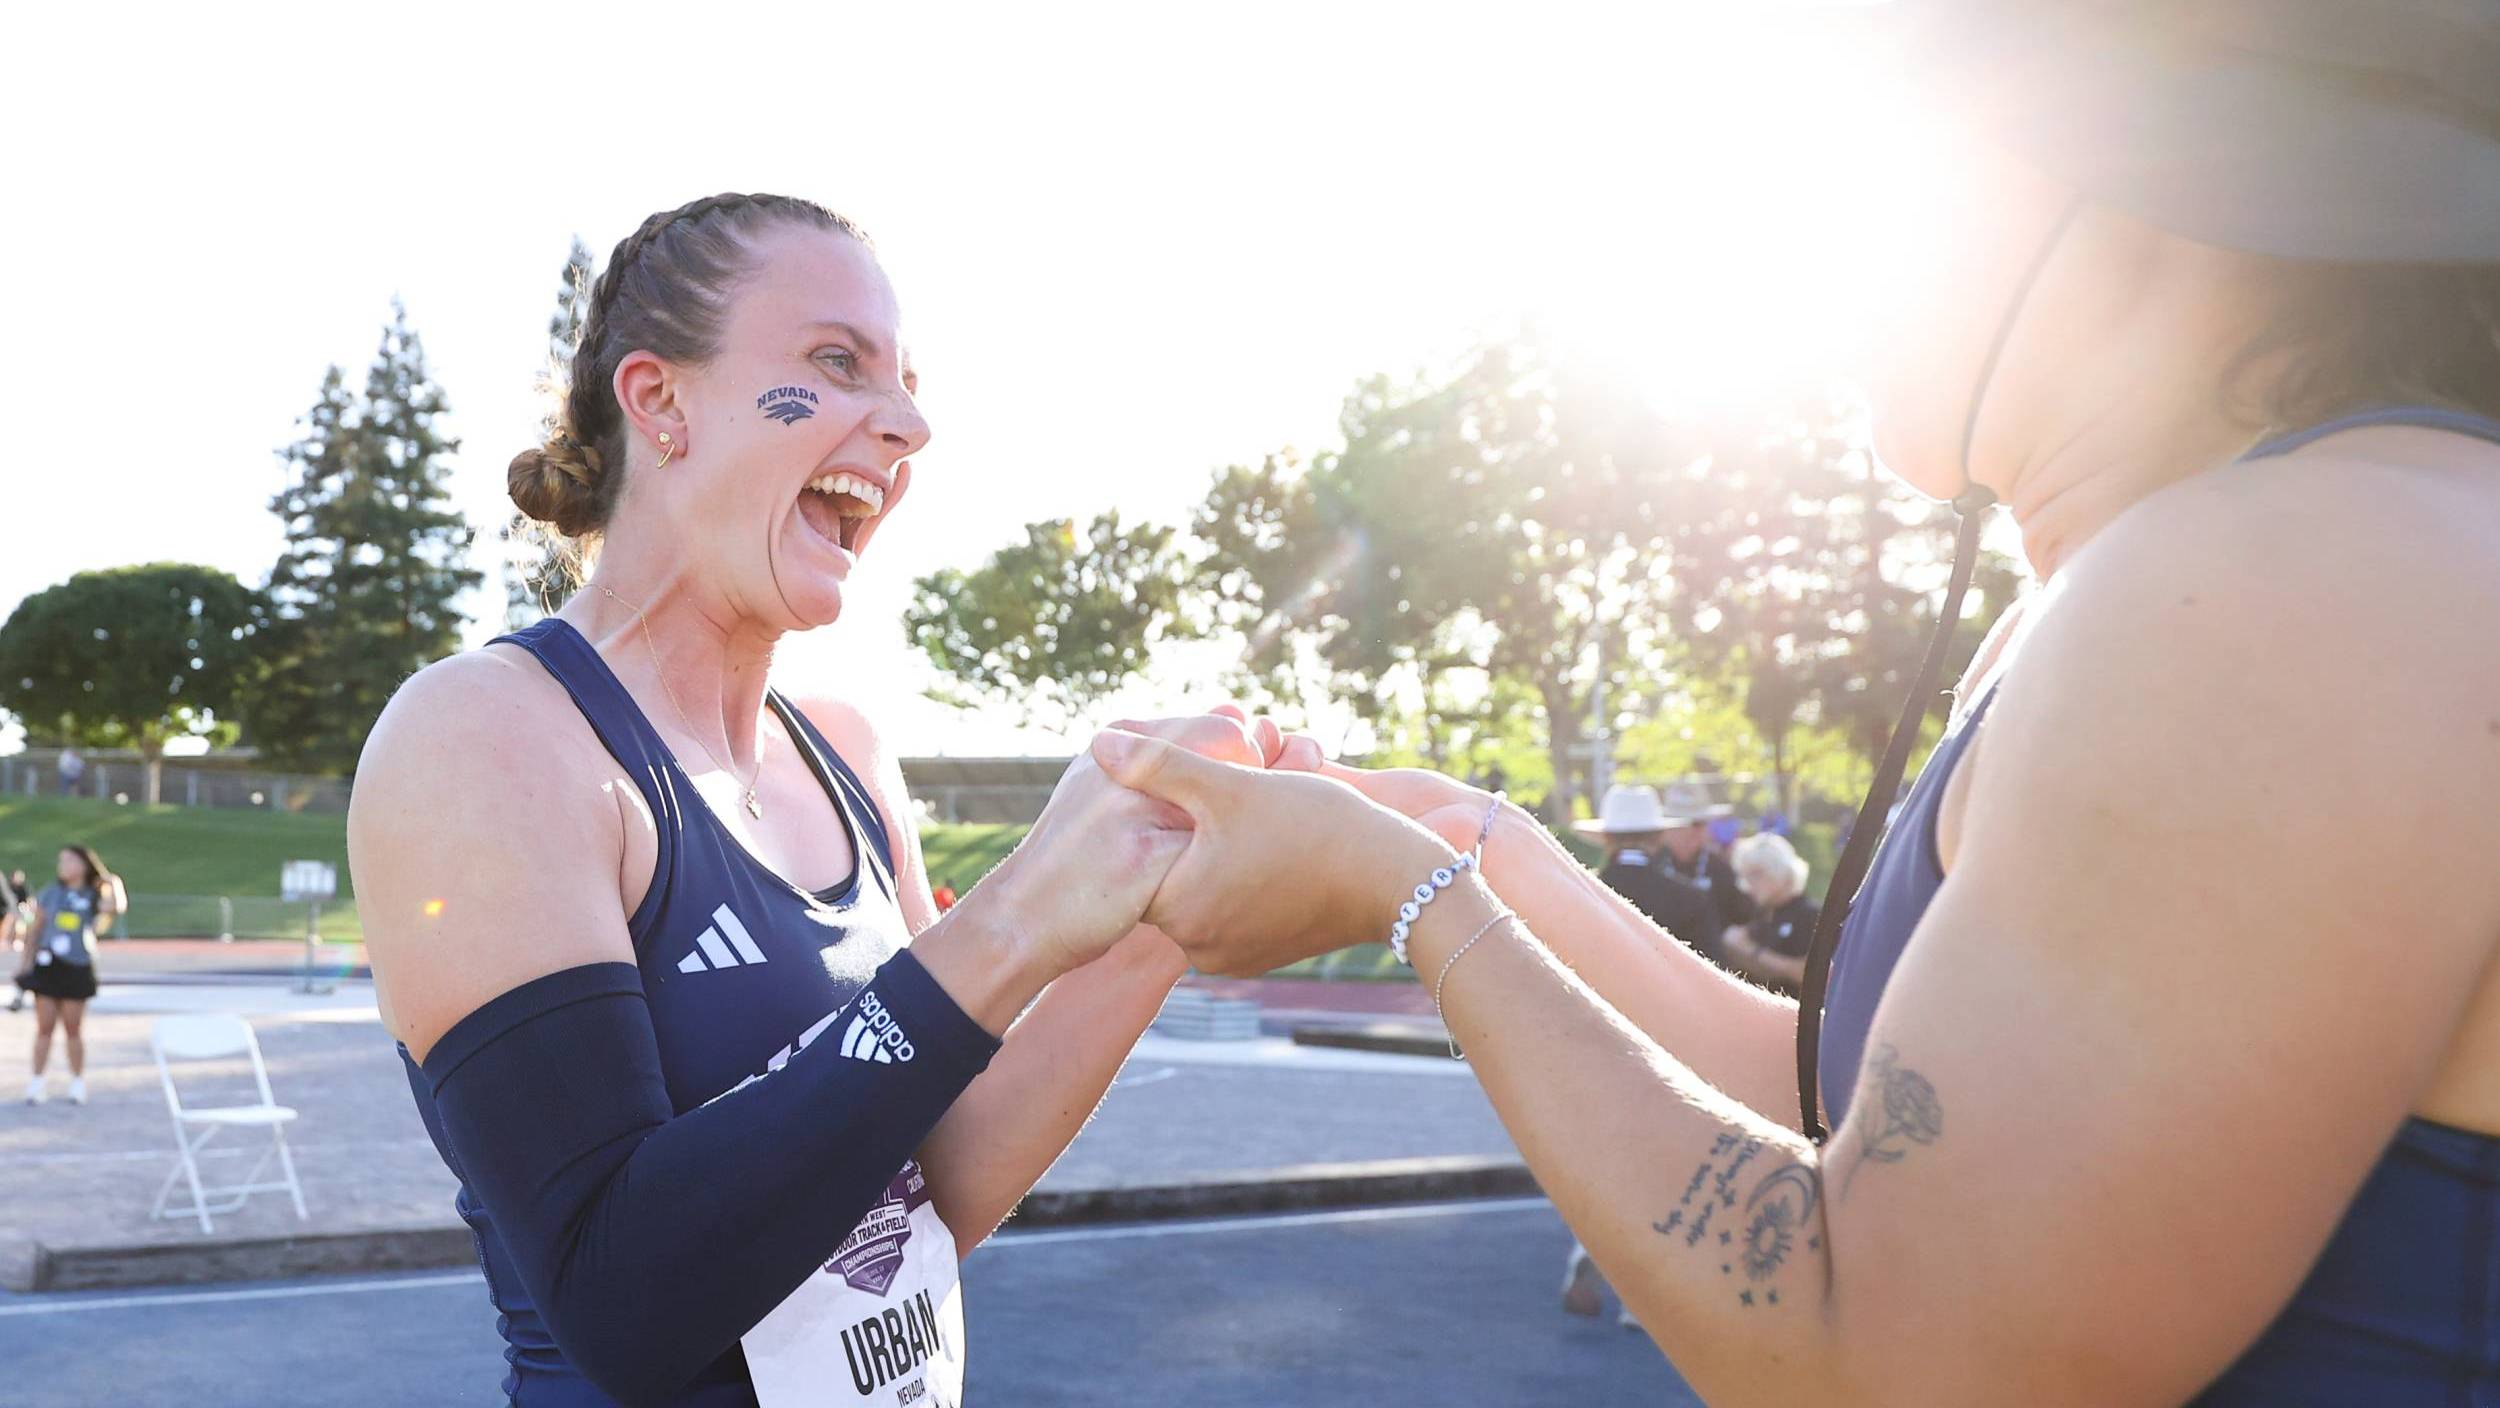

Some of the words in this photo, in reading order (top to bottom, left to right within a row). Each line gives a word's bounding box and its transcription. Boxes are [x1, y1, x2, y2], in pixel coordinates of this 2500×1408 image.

[757, 386, 819, 409] NEVADA
[859, 989, 915, 1062] adidas
[844, 1240, 895, 1270] CHAMPIONSHIPS
[840, 1288, 941, 1396] URBAN
[897, 1377, 927, 1408] NEVADA
